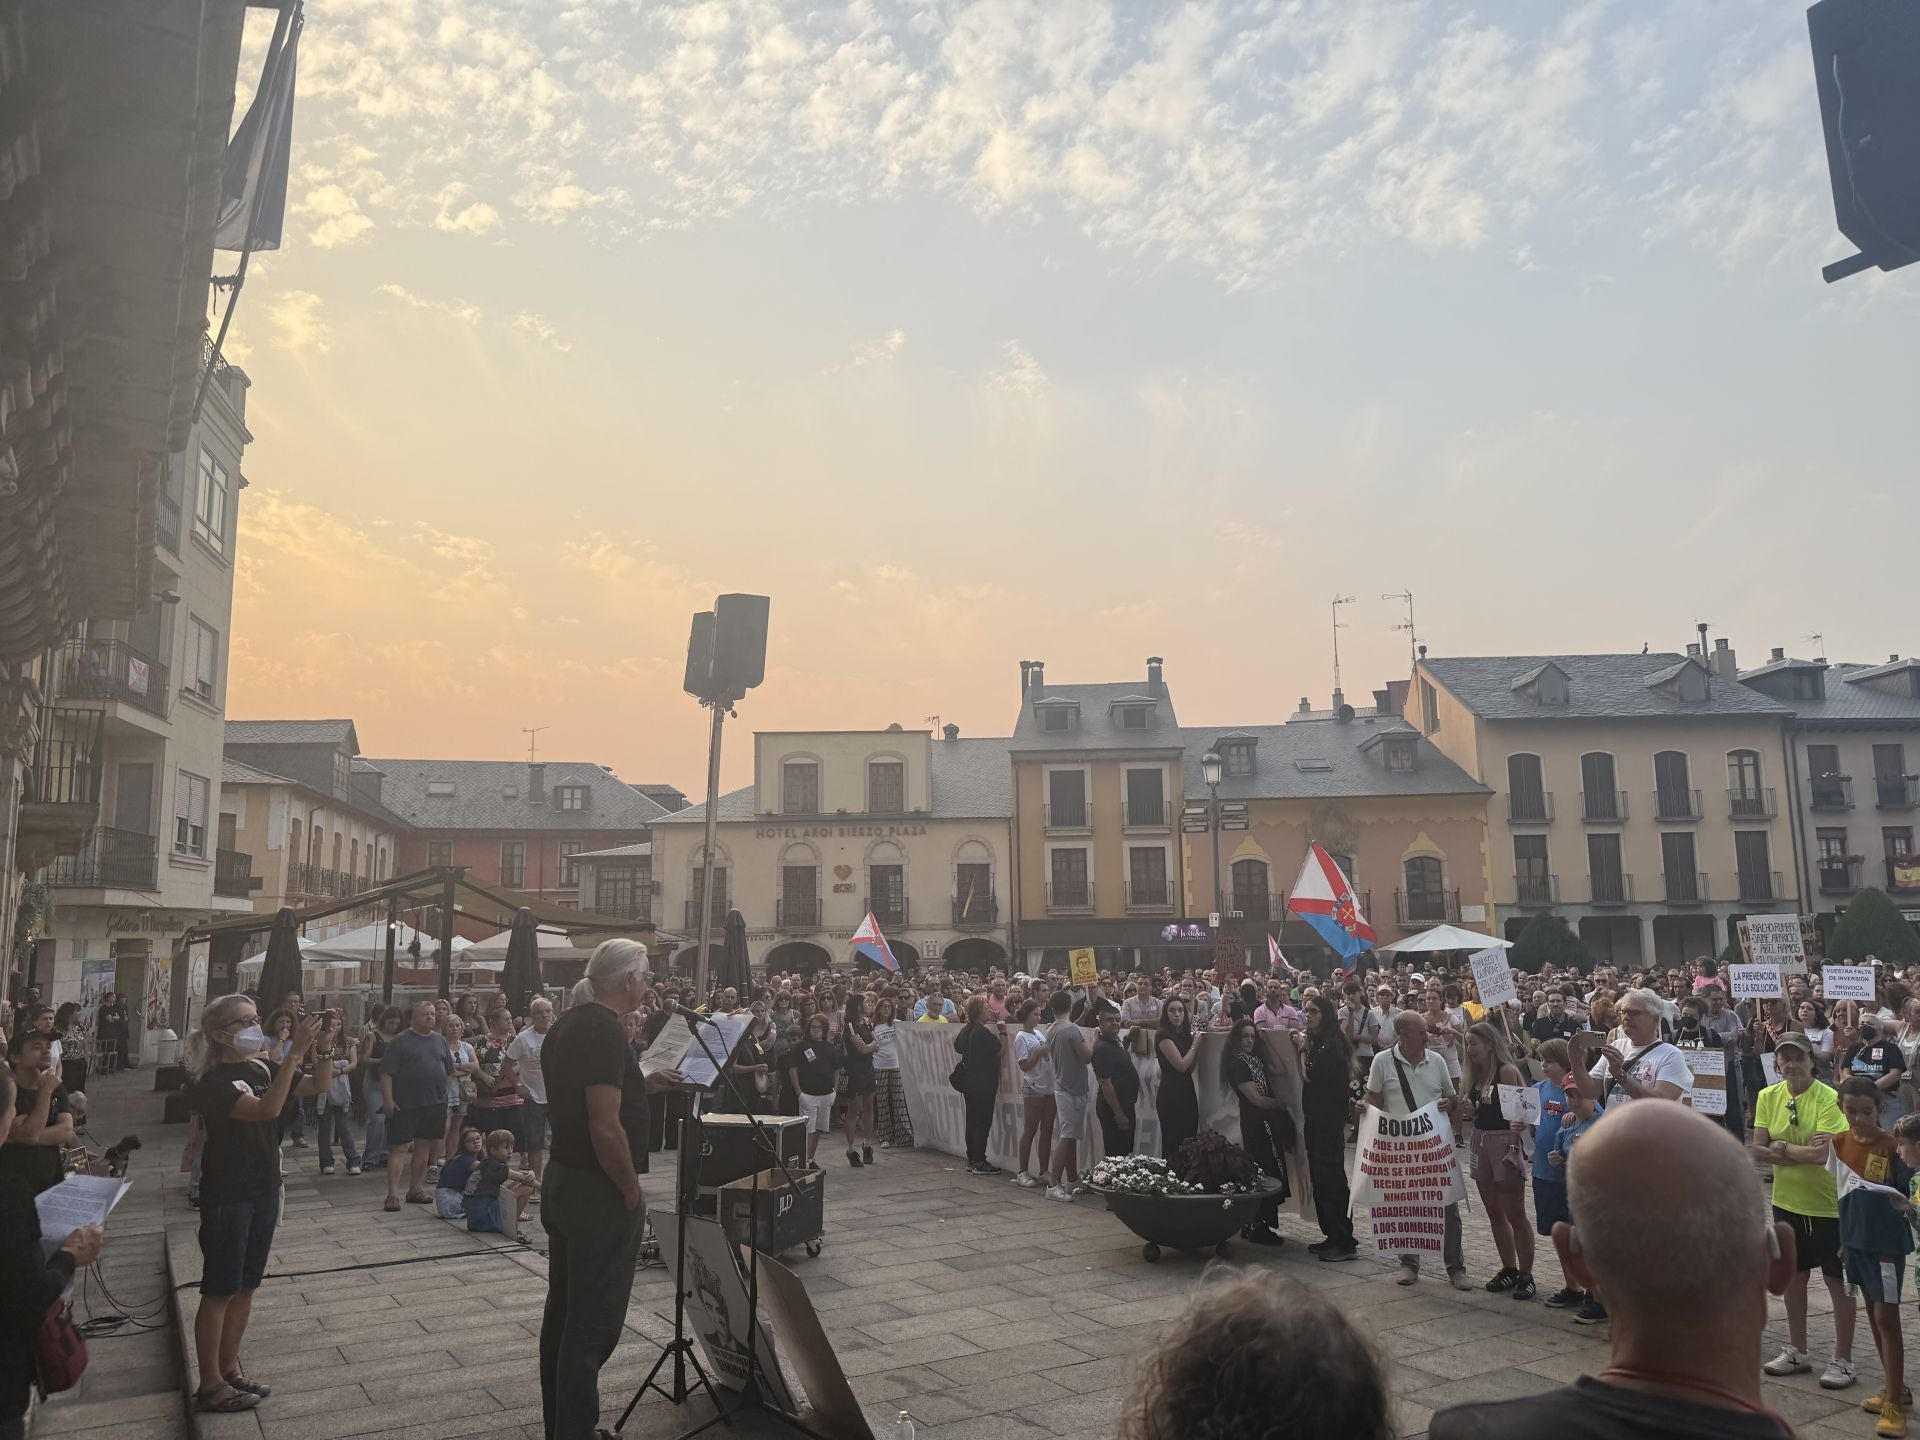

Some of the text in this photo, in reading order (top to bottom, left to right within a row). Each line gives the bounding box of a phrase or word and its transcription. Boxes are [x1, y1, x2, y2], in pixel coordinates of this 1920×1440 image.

[756, 828, 797, 839] HOTEL
[889, 825, 927, 836] PLAZA
[1752, 923, 1774, 933] NACHO
[1734, 970, 1777, 980] LA PREVENCIÓN
[1734, 984, 1741, 992] ES
[1742, 984, 1750, 992] LA
[1378, 1112, 1433, 1137] BOUZAS
[1373, 1138, 1392, 1151] PIDE
[1395, 1142, 1405, 1151] LA
[1368, 1150, 1412, 1164] MAÑUECO
[1415, 1154, 1420, 1162] Y
[1361, 1162, 1390, 1176] BOUZAS
[1392, 1167, 1403, 1176] SE
[1405, 1164, 1448, 1176] INCENDIA
[1373, 1177, 1452, 1189] RECIBE AYUDA DE
[1421, 1190, 1443, 1200] TIPO
[777, 1194, 793, 1217] JLD
[1372, 1206, 1444, 1218] AGRADECIMIENTO
[1374, 1222, 1444, 1235] A DOS BOMBEROS
[1378, 1238, 1440, 1251] DE PONFERRADA
